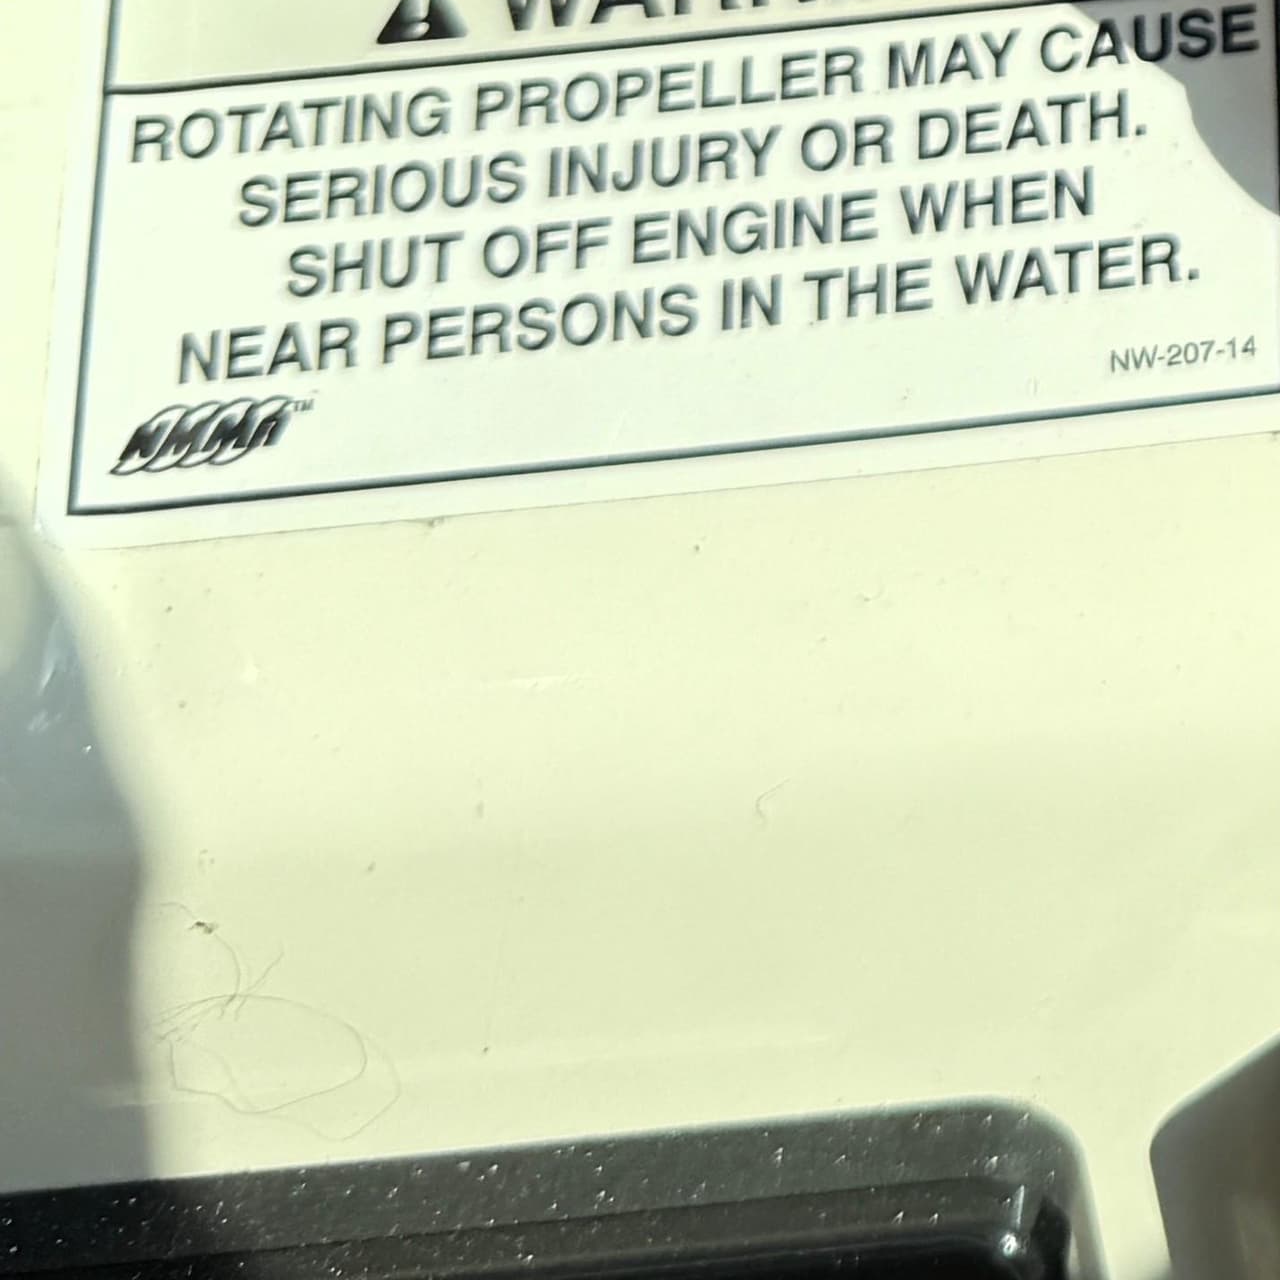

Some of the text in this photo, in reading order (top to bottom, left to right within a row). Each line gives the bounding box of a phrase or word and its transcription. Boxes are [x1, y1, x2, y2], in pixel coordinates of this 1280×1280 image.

[130, 2, 1261, 164] ROTATING PROPELLER MAY CAUSE
[239, 89, 1147, 228] SERIOUS INJURY OR DEATH.
[287, 165, 1095, 297] SHUT OFF ENGINE WHEN
[178, 232, 1200, 384] NEAR PERSONS IN THE WATER.
[1109, 335, 1258, 374] NW-207-14
